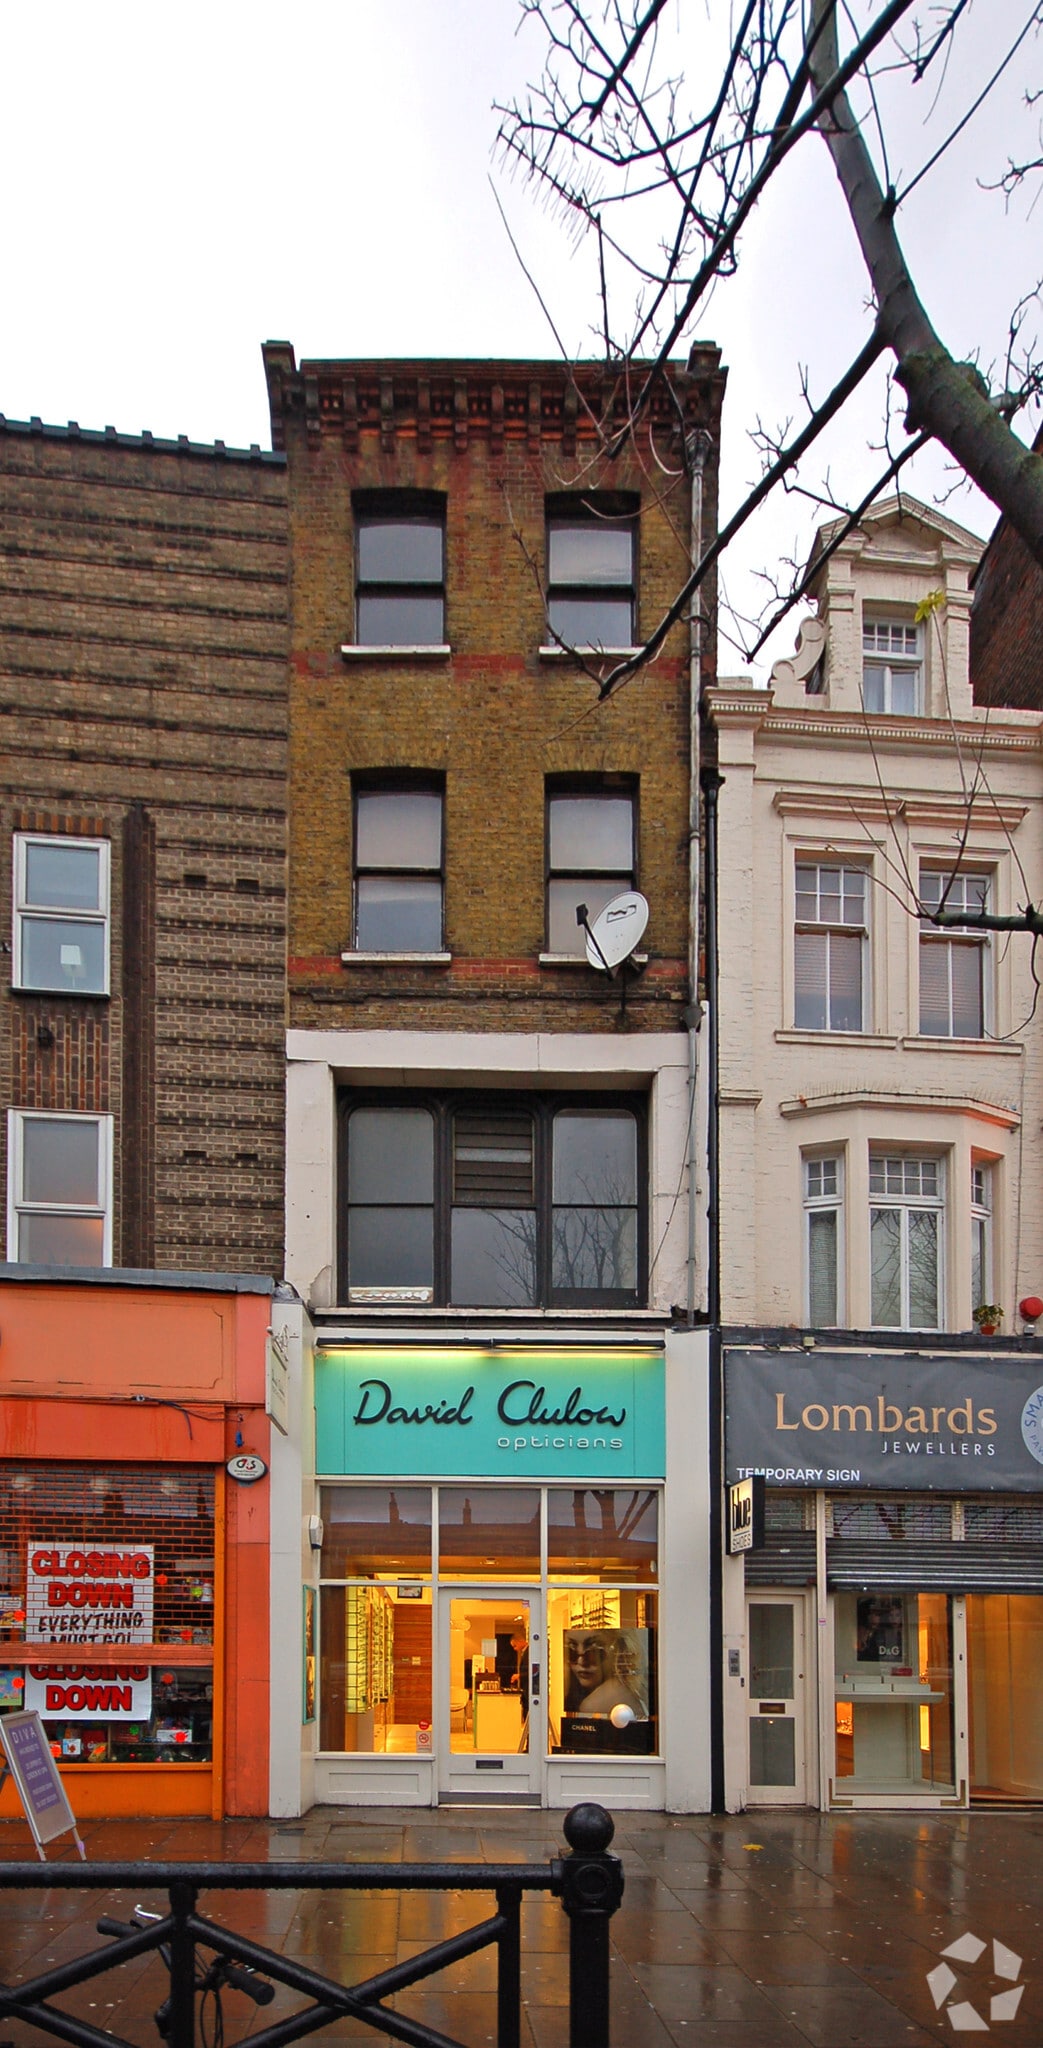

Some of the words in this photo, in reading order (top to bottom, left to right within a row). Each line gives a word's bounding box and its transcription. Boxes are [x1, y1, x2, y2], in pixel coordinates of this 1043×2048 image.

[353, 1379, 475, 1425] David
[497, 1380, 626, 1426] Clulow
[775, 1393, 998, 1435] Lombards
[497, 1435, 623, 1450] opticians
[881, 1441, 996, 1456] JEWELLERS
[826, 1469, 860, 1481] SIGN
[732, 1487, 751, 1531] blue
[31, 1550, 151, 1579] CLOSING
[47, 1582, 134, 1608] DOWN
[38, 1612, 144, 1633] EVERYTHING
[878, 1645, 900, 1656] D&G
[29, 1664, 148, 1681] CLOSING
[45, 1684, 133, 1711] DOWN
[11, 1726, 37, 1744] DIVA
[571, 1724, 597, 1732] CHANEL
